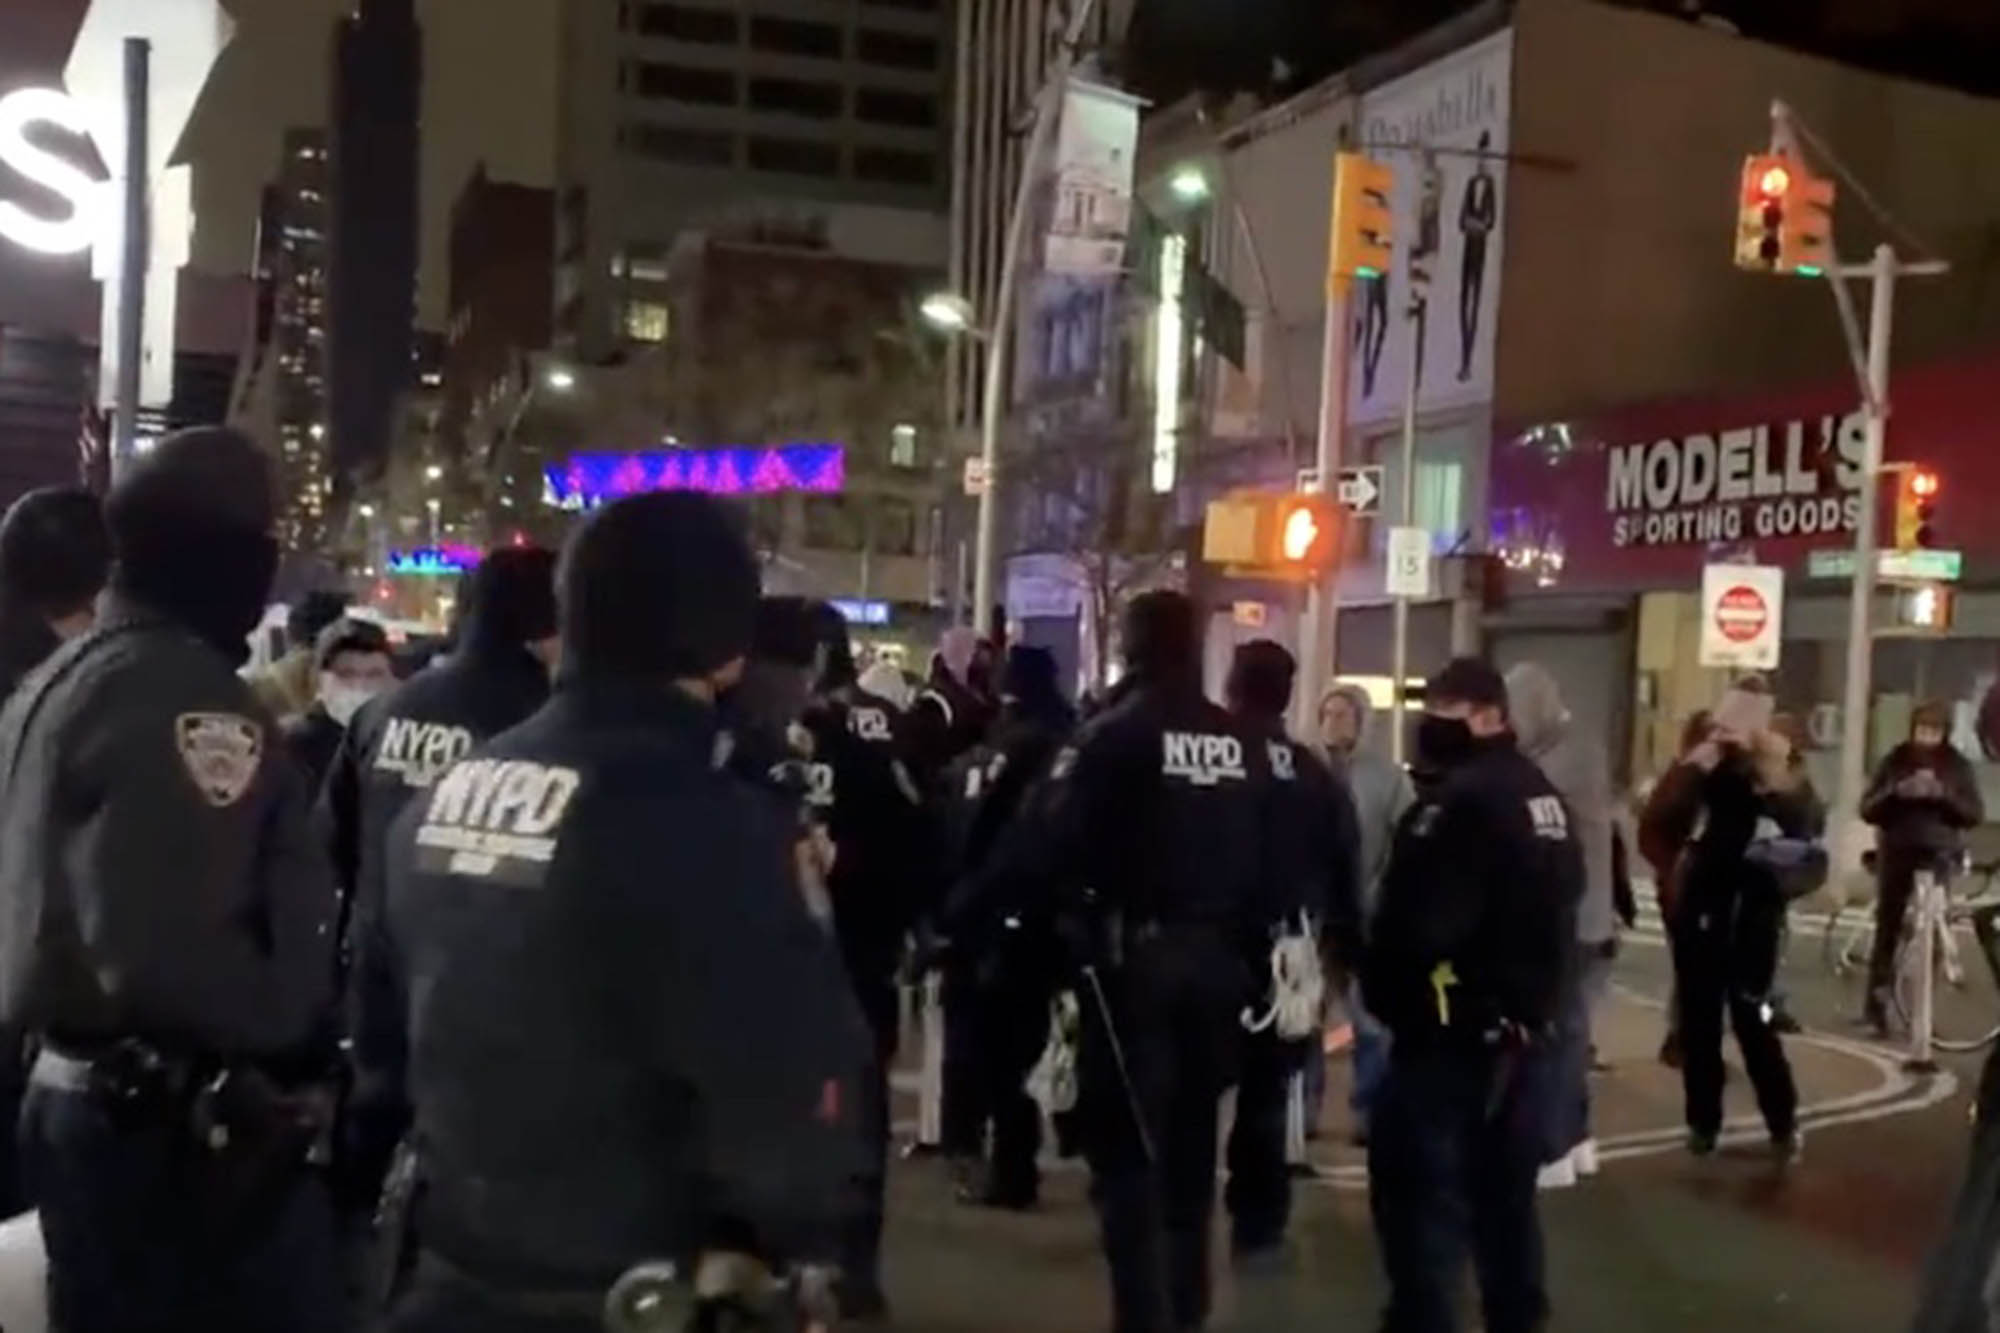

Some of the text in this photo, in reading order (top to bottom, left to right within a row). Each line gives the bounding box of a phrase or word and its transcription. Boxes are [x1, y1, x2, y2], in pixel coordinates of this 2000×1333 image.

[1606, 411, 1866, 511] MODELL'S
[1613, 496, 1861, 547] SPORTING GOODS
[380, 717, 472, 770] NYPD
[1163, 732, 1242, 767] NYPD
[427, 757, 580, 833] NYPD
